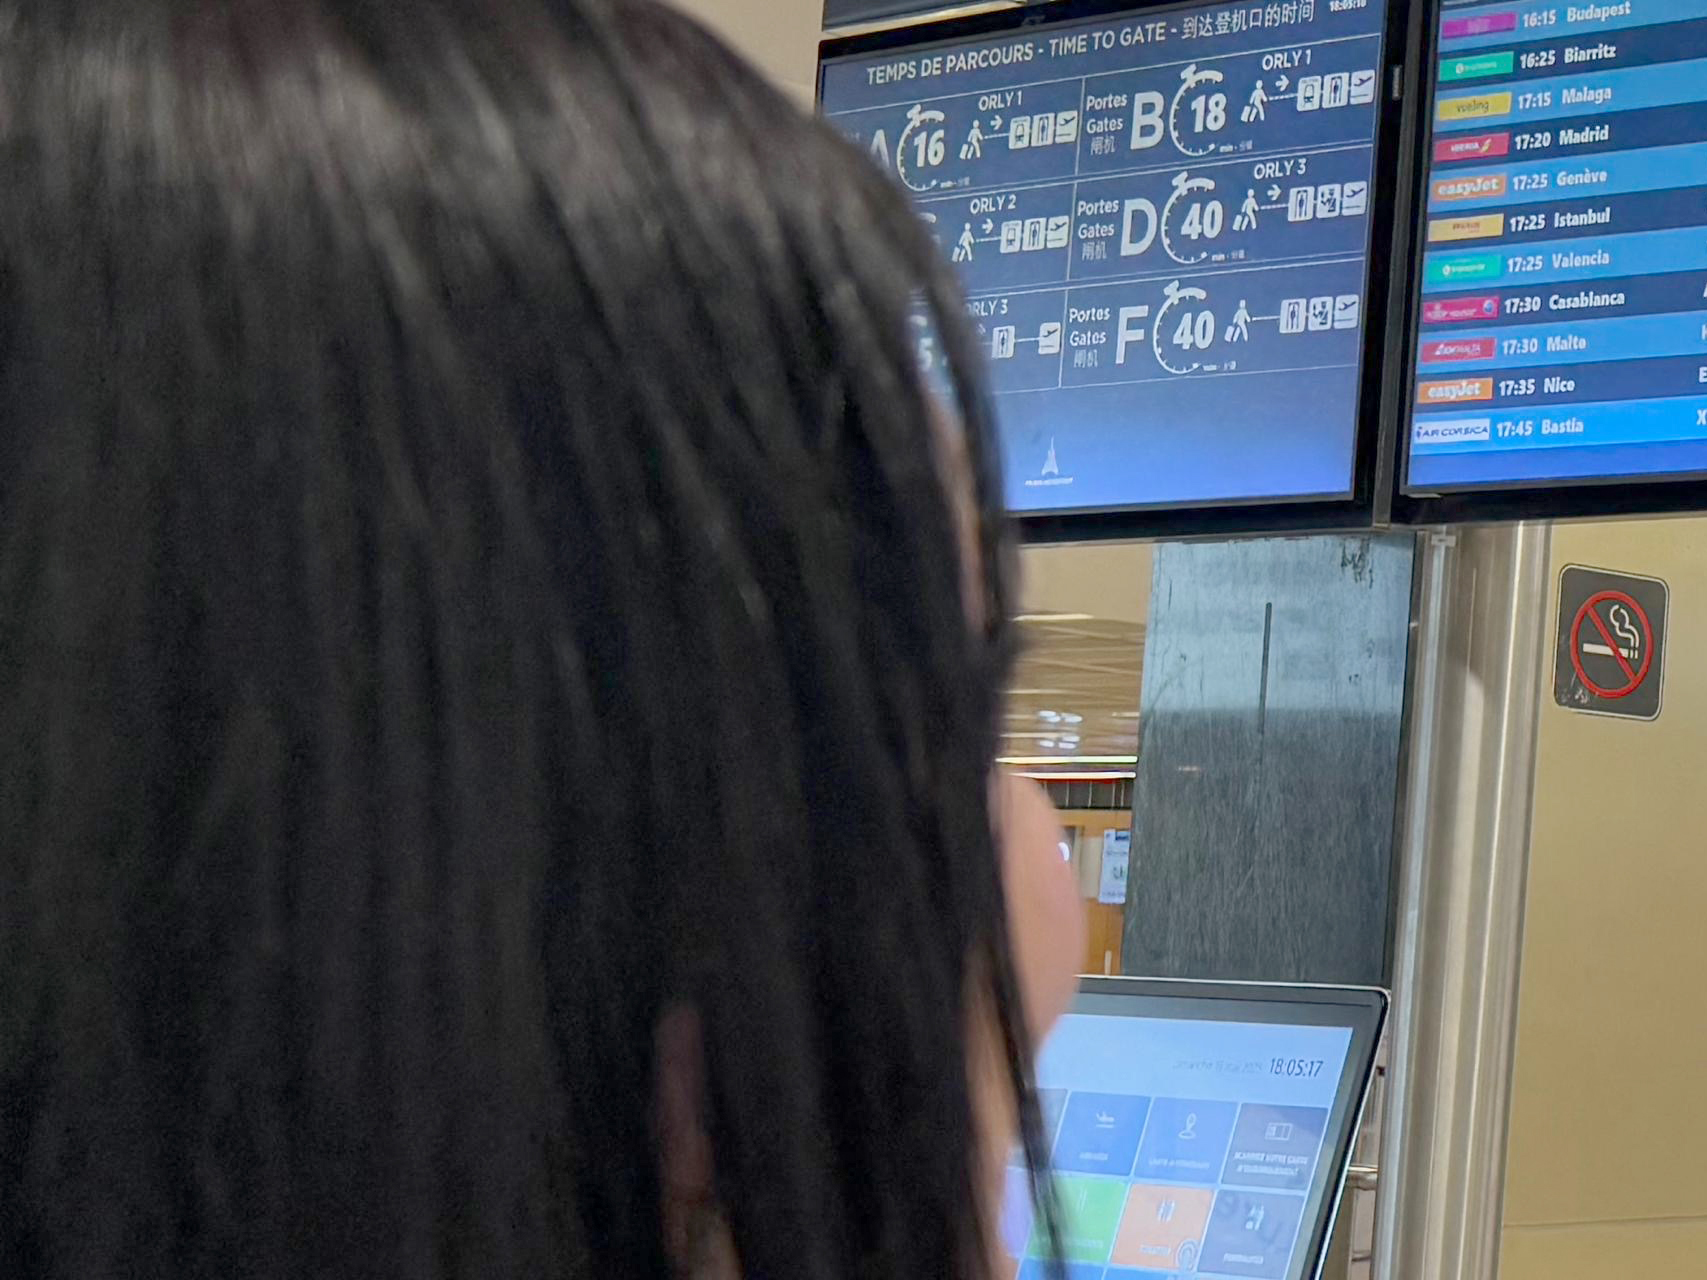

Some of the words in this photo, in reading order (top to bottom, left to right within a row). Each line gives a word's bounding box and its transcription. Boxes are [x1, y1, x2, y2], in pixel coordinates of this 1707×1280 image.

[866, 61, 917, 86] TEMPS
[920, 57, 943, 78] DE
[945, 42, 1034, 73] PARCOURS
[1049, 35, 1088, 58] TIME
[1091, 29, 1116, 50] TO
[1119, 22, 1167, 46] GATE
[1261, 51, 1303, 72] ORLY
[1306, 49, 1313, 66] 1
[978, 91, 1015, 112] ORLY
[1086, 92, 1128, 112] Portes
[1130, 90, 1165, 151] B
[1190, 92, 1227, 133] 18
[1086, 116, 1124, 135] Gates
[913, 129, 945, 167] 16
[1514, 131, 1551, 150] 17:20
[1558, 124, 1609, 145] Madrid
[1253, 161, 1294, 180] ORLY
[1297, 158, 1308, 174] 3
[970, 195, 1006, 214] ORLY
[1007, 193, 1018, 210] 2
[1077, 199, 1120, 217] Portes
[1119, 198, 1159, 257] D
[1179, 200, 1224, 240] 40
[1078, 222, 1115, 240] Gates
[1115, 304, 1150, 365] F
[1172, 309, 1216, 351] 40
[1269, 1056, 1325, 1079] 18:05:17
